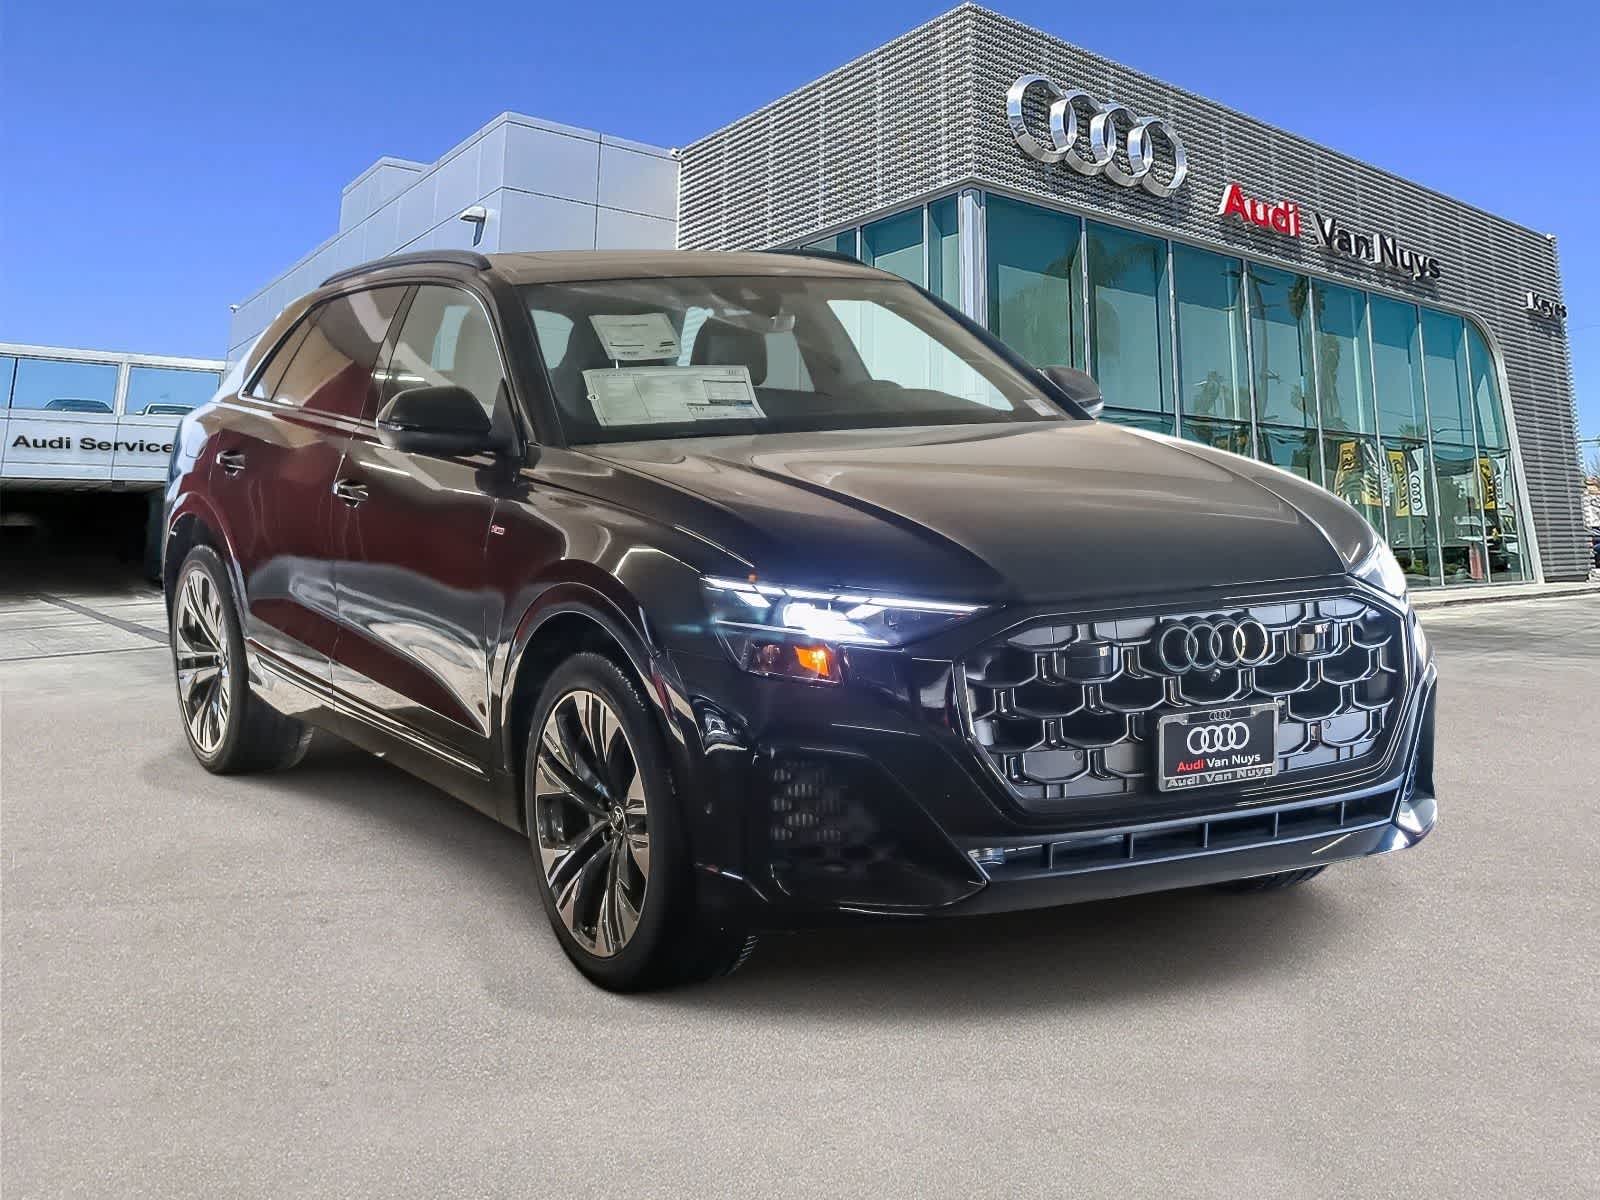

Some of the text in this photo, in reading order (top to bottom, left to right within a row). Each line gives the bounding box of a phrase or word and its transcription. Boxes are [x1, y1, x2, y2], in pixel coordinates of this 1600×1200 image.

[1217, 183, 1441, 280] Audi Van Nuys
[1526, 291, 1568, 319] Keyes
[12, 435, 174, 453] Audi Service
[1176, 754, 1261, 773] Audi Van Nuys
[1167, 766, 1272, 788] Audi Van Nuys
